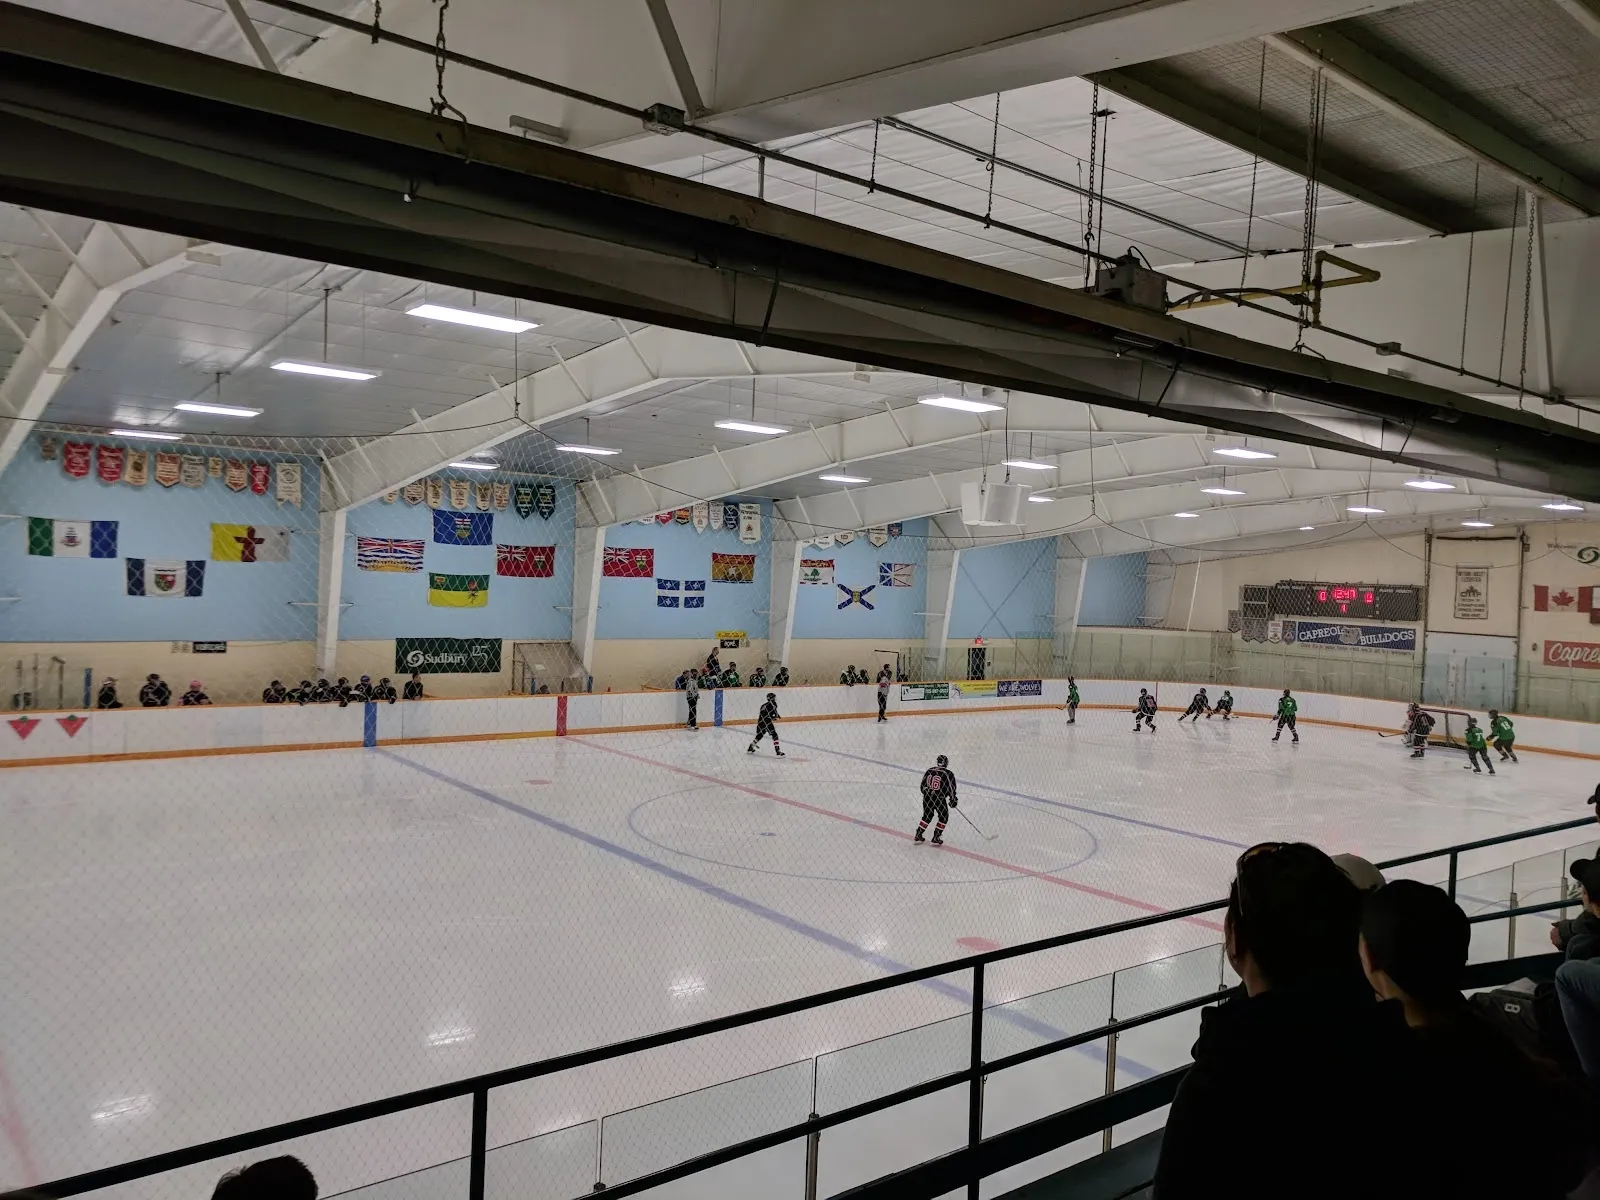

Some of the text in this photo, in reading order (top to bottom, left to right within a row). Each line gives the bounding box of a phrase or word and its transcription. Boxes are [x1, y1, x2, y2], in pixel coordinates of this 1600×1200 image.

[1299, 626, 1415, 645] CAPREOL BULLDOGS
[424, 652, 468, 666] Sudbury
[927, 774, 941, 791] 16
